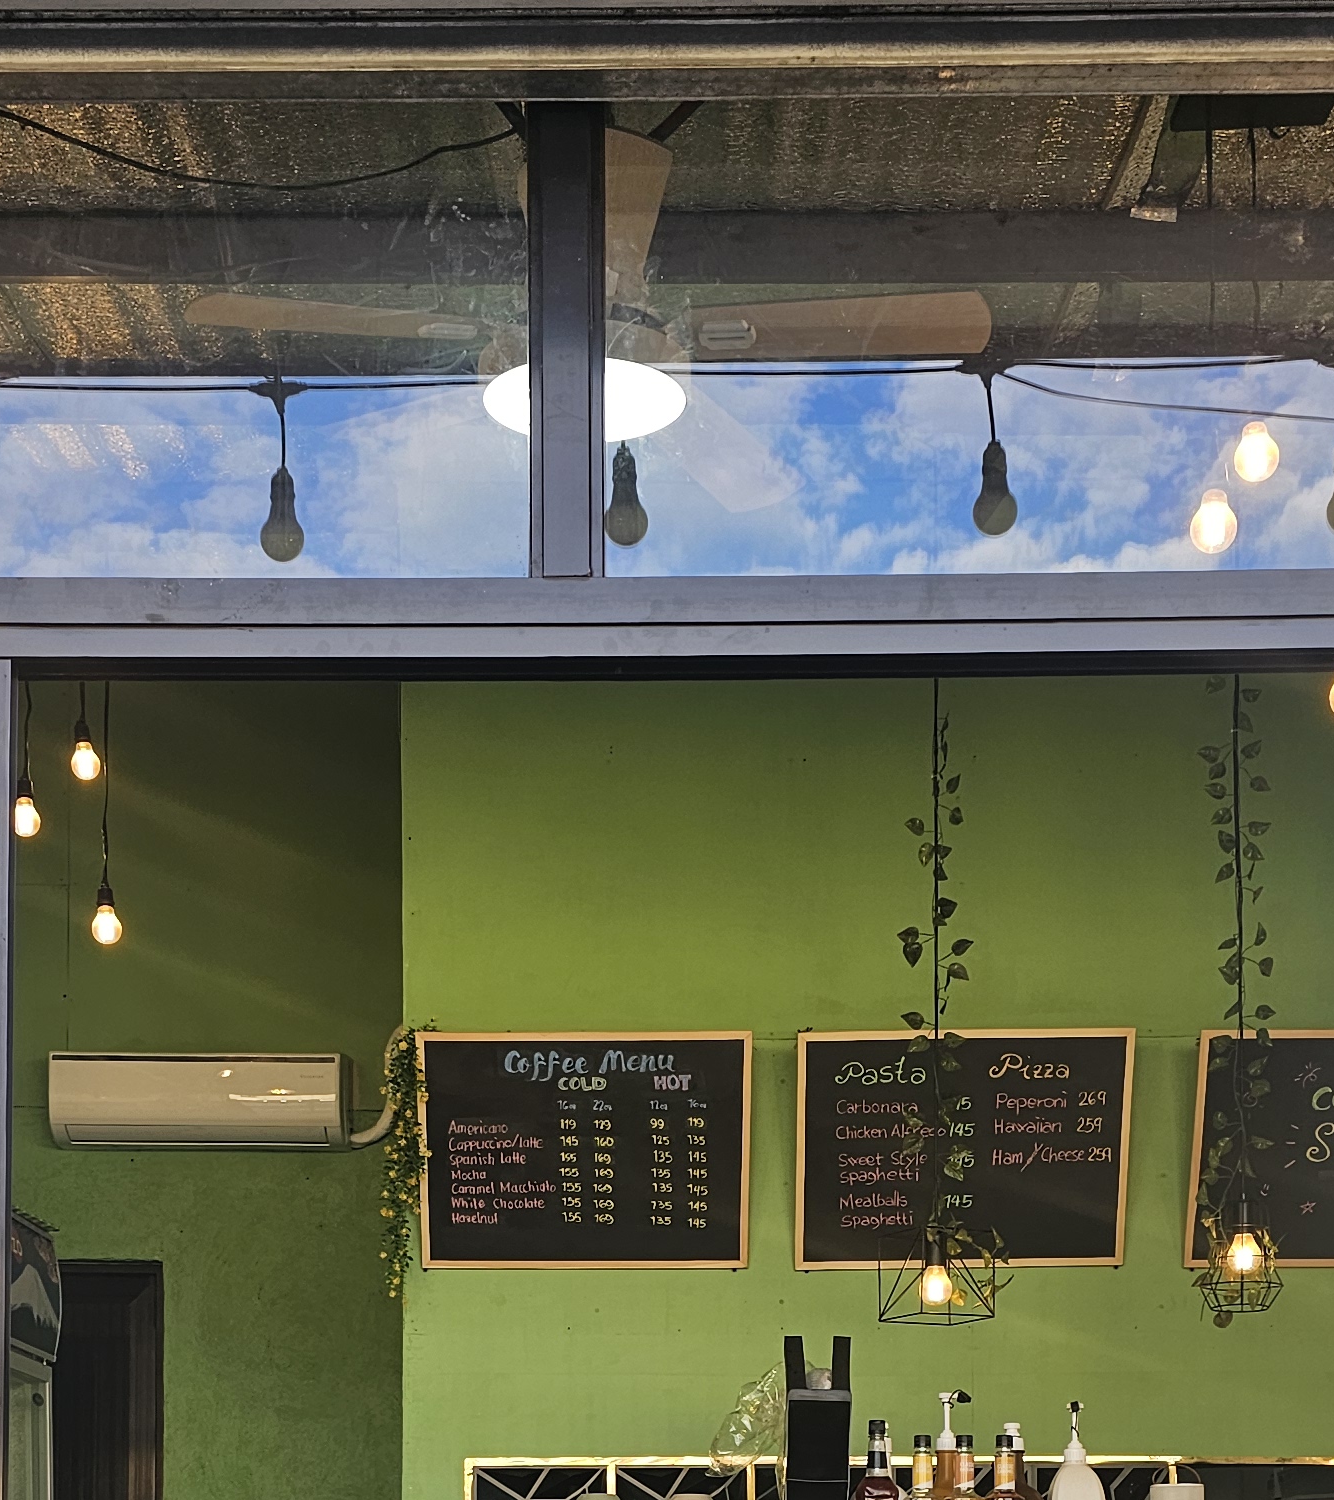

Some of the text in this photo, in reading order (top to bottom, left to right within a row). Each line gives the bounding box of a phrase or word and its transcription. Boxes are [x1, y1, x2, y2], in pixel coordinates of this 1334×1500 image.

[504, 1049, 675, 1081] Coffee Menu
[835, 1055, 926, 1085] Pasta
[989, 1053, 1070, 1079] Pizza
[557, 1074, 692, 1091] COLD HOT
[836, 1099, 919, 1114] Carbonara
[996, 1090, 1107, 1115] Peperoni 269
[448, 1120, 508, 1135] Americano
[650, 1118, 665, 1129] 99
[687, 1117, 704, 1128] 119
[835, 1125, 888, 1140] Chicken
[949, 1122, 976, 1137] 145
[1076, 1116, 1103, 1134] 259
[560, 1135, 579, 1147] 145
[687, 1134, 706, 1146] 135
[653, 1149, 673, 1163] 135
[838, 1152, 884, 1167] Sweet
[890, 1151, 928, 1170] Style
[1087, 1146, 1112, 1163] 259
[451, 1169, 487, 1181] Mocha
[651, 1168, 671, 1178] 135
[687, 1168, 708, 1179] 145
[451, 1181, 495, 1194] Caramel
[500, 1180, 556, 1193] Macchiato
[561, 1182, 581, 1192] 155
[652, 1182, 673, 1193] 135
[687, 1183, 709, 1196] 145
[451, 1197, 486, 1209] White
[493, 1197, 545, 1210] Chocolate
[688, 1201, 708, 1212] 145
[839, 1190, 973, 1210] Meatballs 145
[650, 1215, 672, 1225] 135
[687, 1217, 707, 1229] 145
